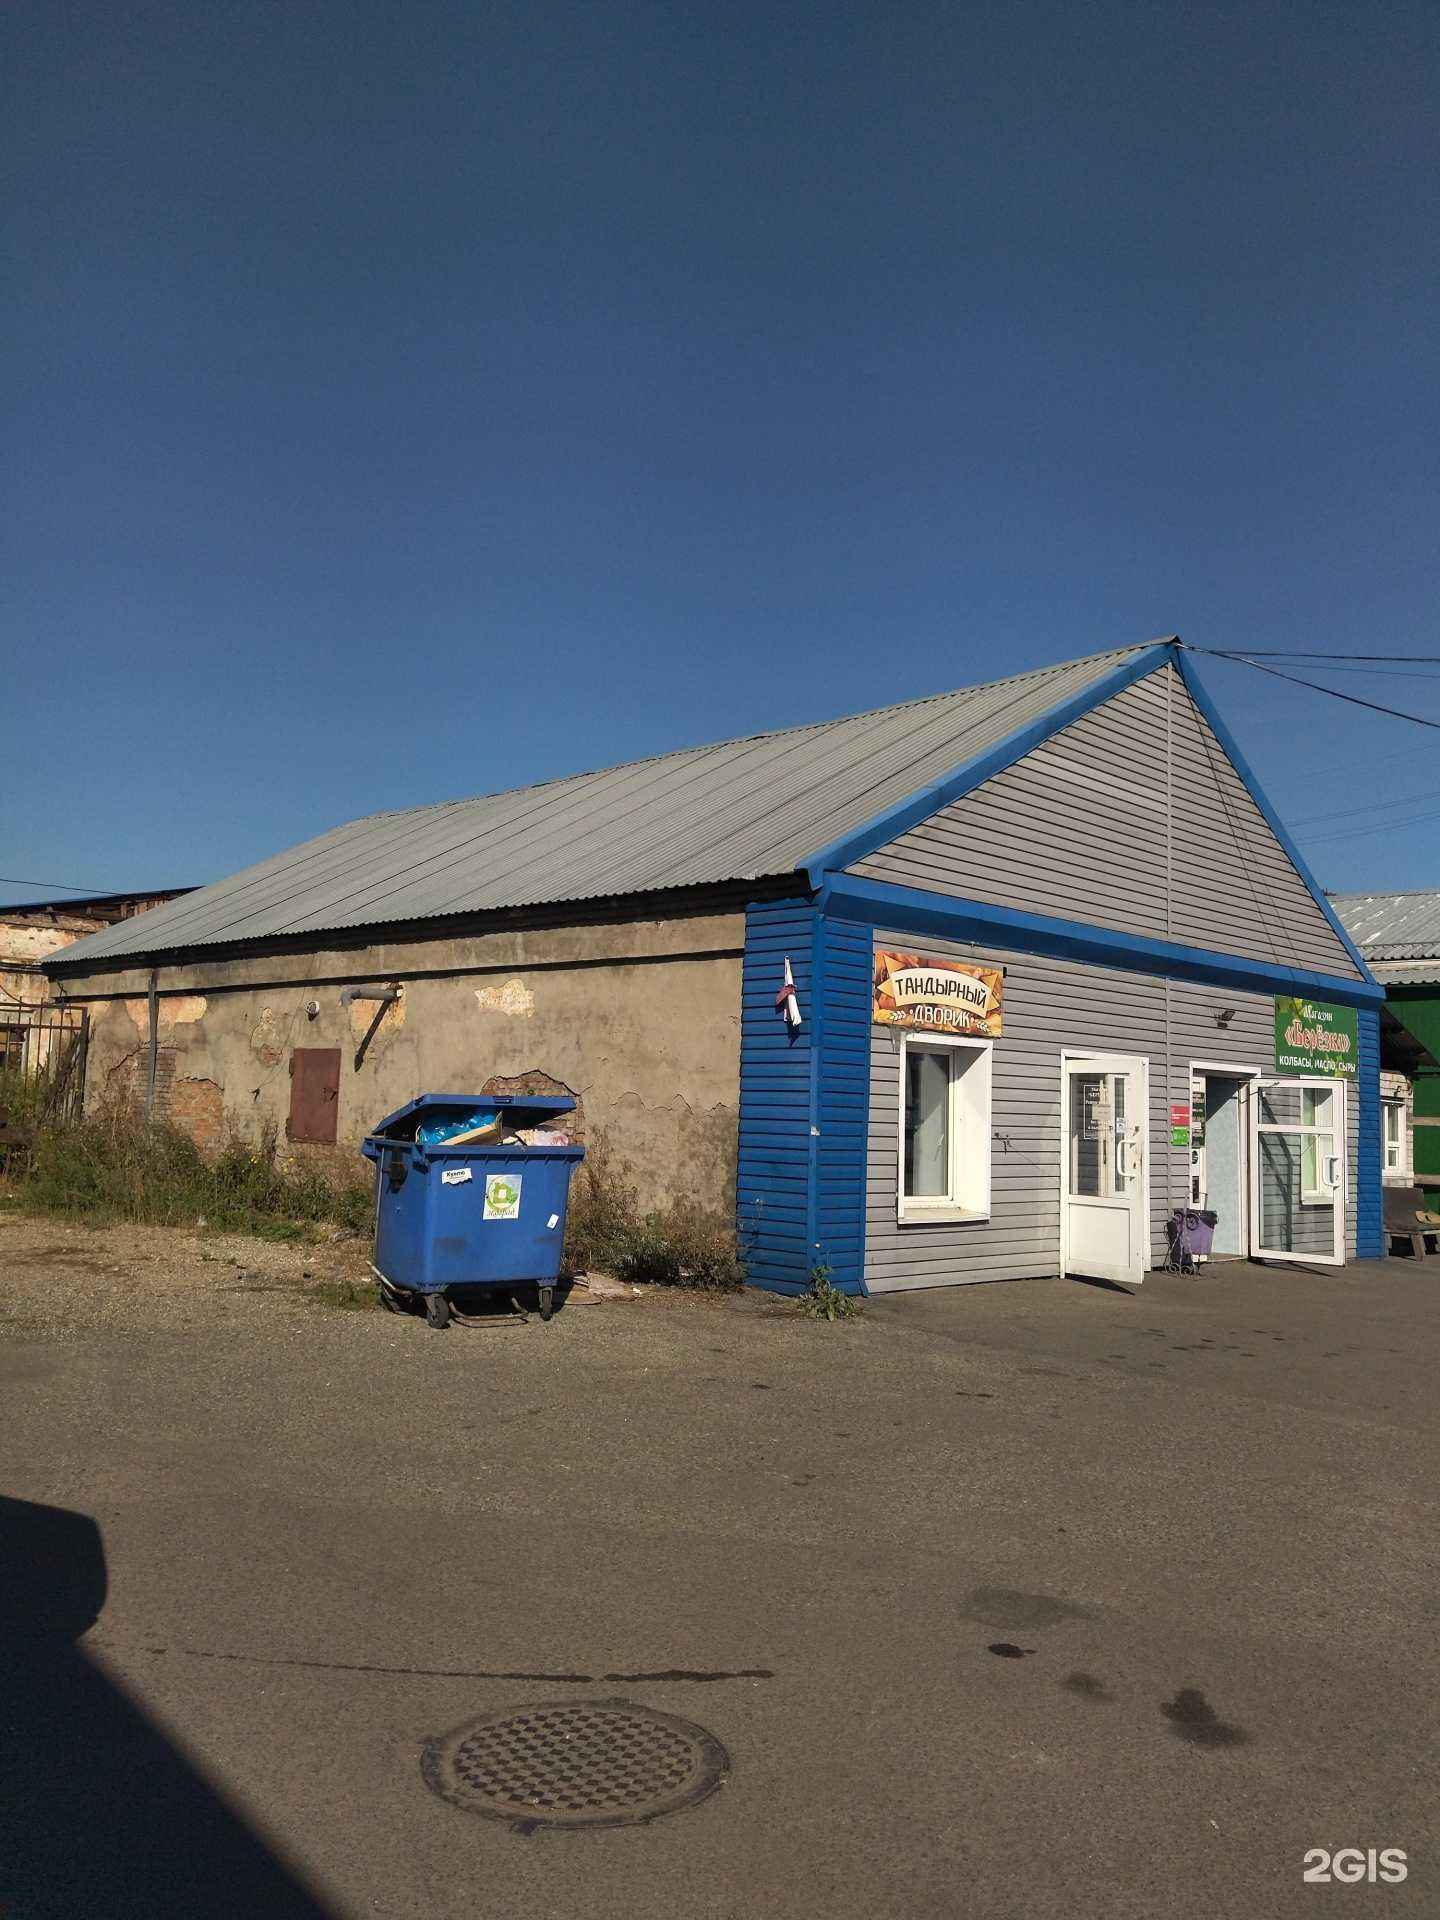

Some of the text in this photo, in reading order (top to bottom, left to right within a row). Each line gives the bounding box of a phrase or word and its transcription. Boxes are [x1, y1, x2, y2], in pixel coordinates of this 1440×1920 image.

[895, 977, 987, 1008] ТАНДЫРНЫЙ
[913, 1004, 970, 1027] ДВОРИК
[1279, 1055, 1313, 1069] КОЛБАСЫ,
